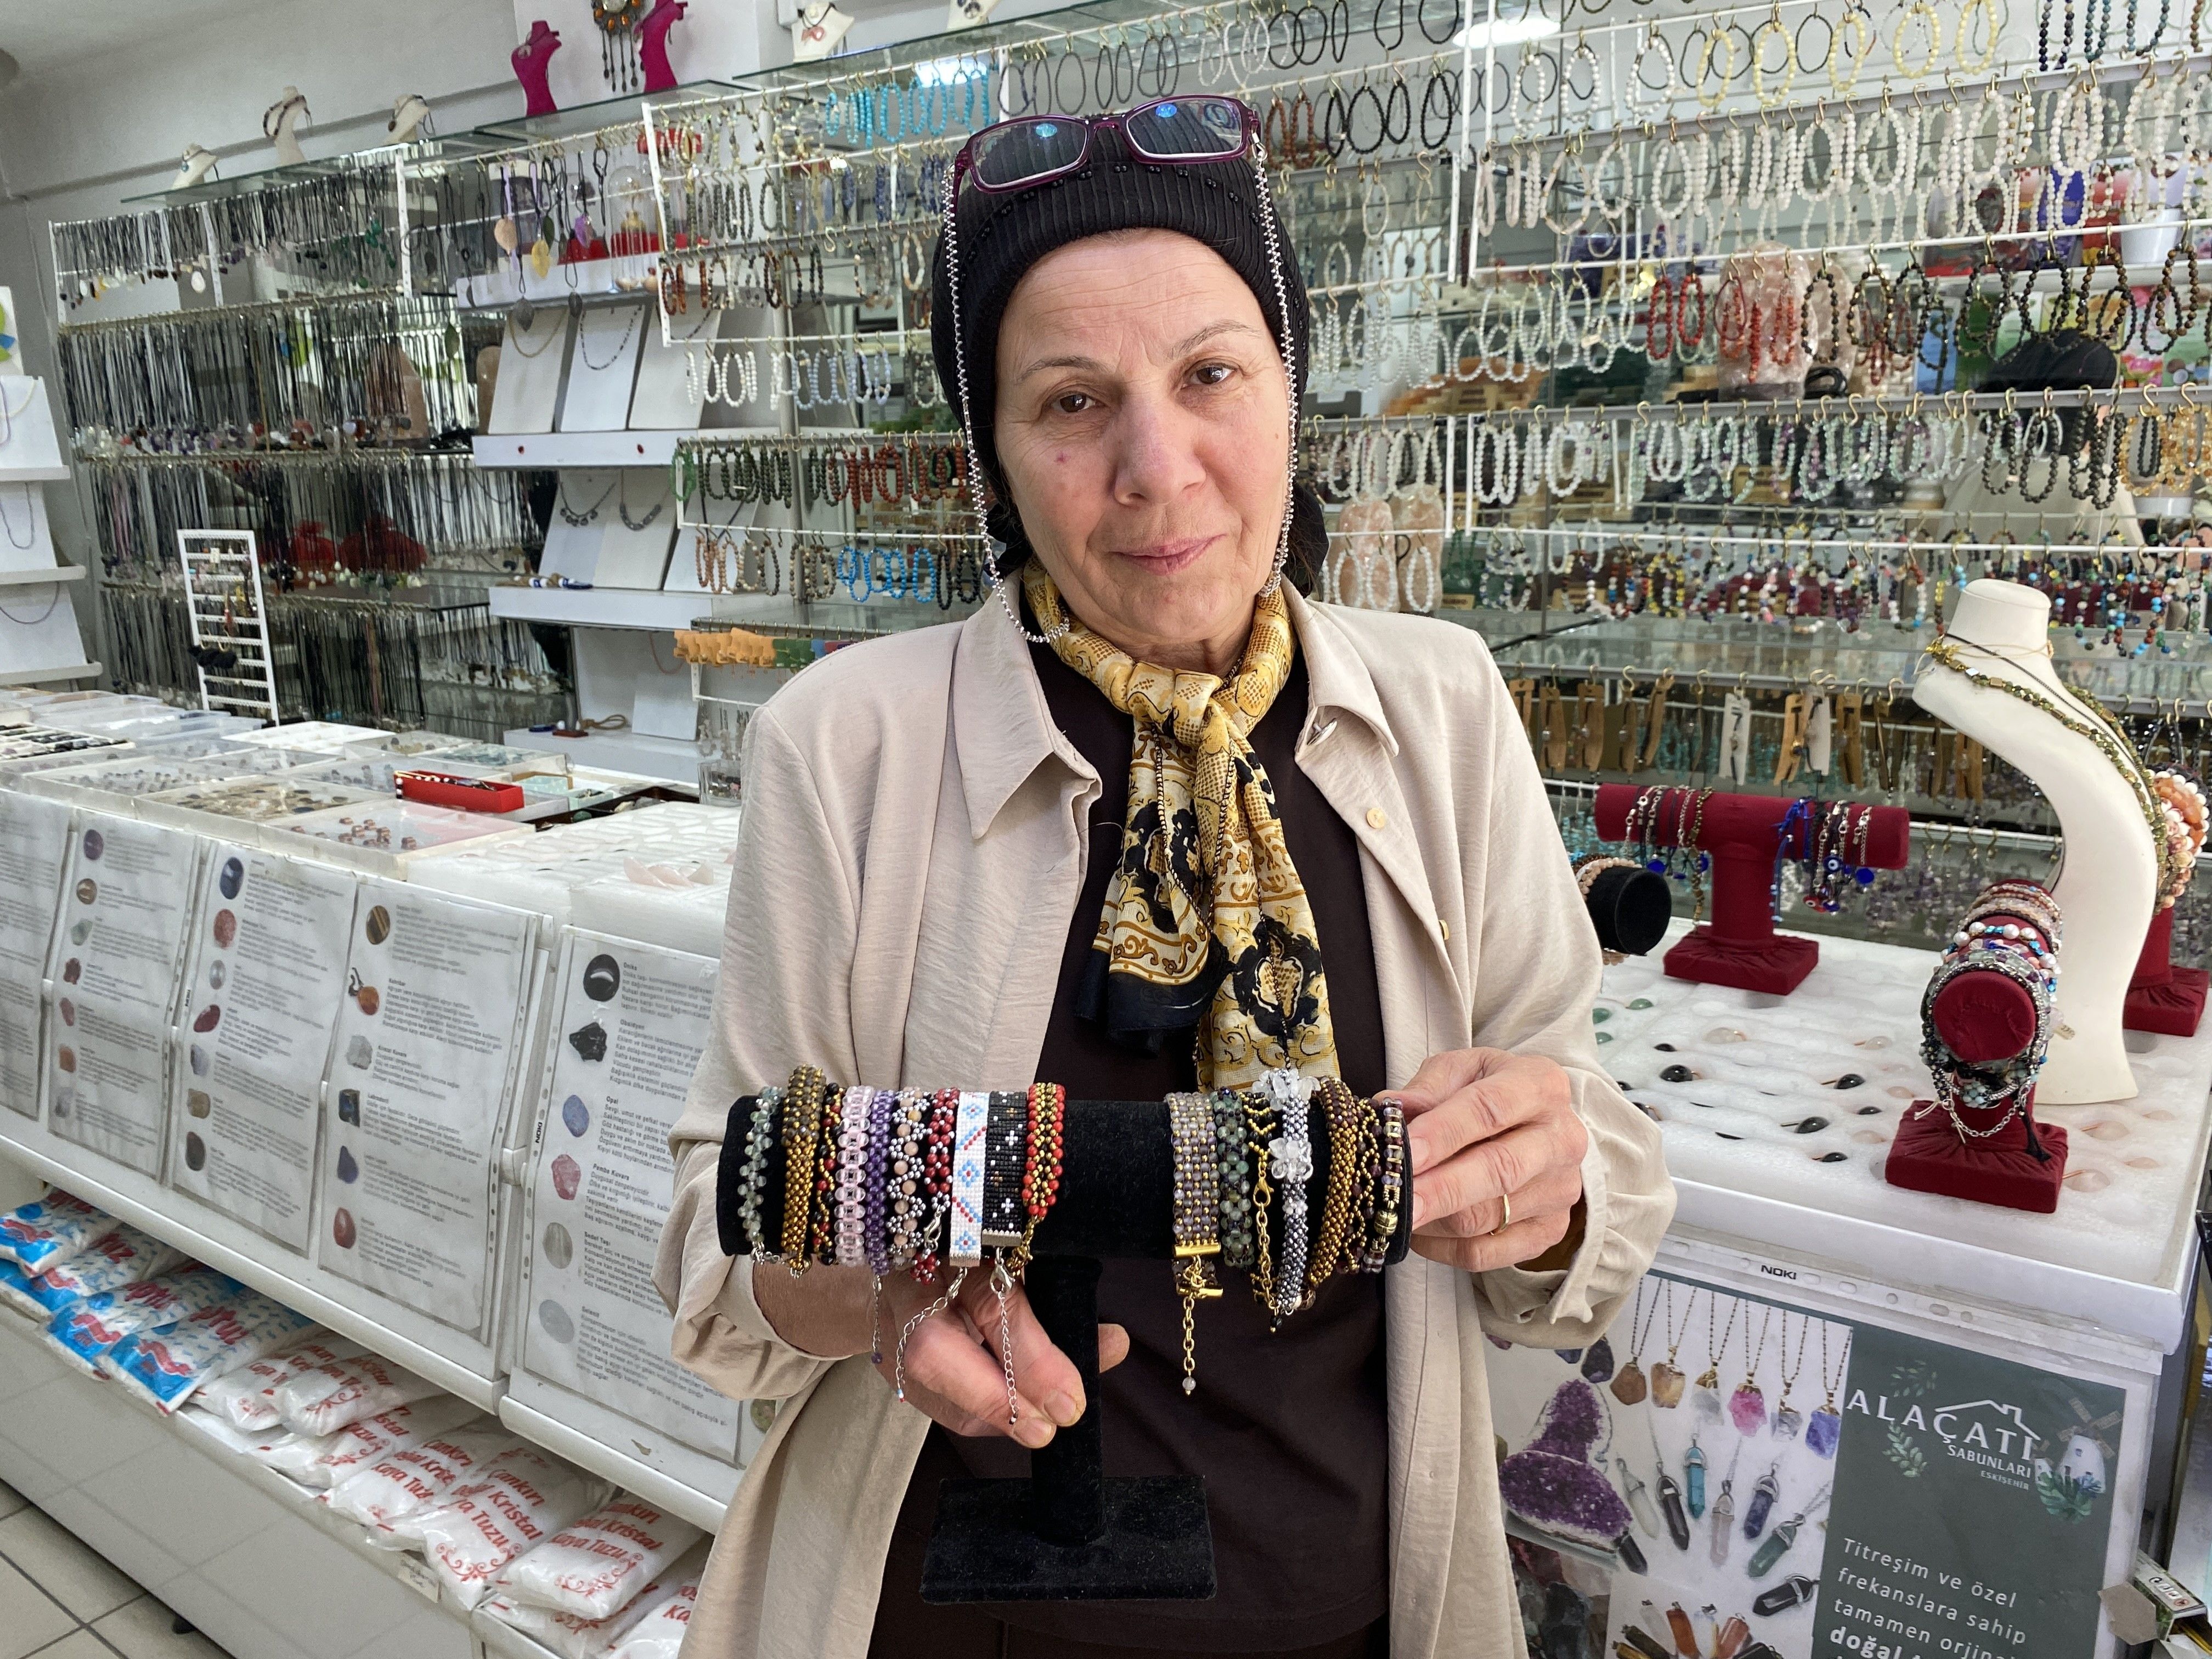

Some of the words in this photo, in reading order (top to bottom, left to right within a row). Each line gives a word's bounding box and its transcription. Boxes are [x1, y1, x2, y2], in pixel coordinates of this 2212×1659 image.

[606, 1096, 619, 1104] Opal
[593, 1164, 610, 1173] Pembe
[611, 1170, 629, 1180] Kuvars
[1760, 1265, 1797, 1280] NOKI
[1846, 1389, 2034, 1460] ALAÇATI
[1947, 1444, 2031, 1478] SABUNLARI
[487, 1469, 545, 1507] Çankırı
[470, 1510, 509, 1549] Tuzu
[488, 1491, 544, 1540] Kristal
[1844, 1538, 1929, 1579] Titreşim
[1939, 1572, 1962, 1589] ve
[1971, 1582, 2017, 1609] özel
[1835, 1599, 1931, 1643] tamamen
[1838, 1567, 1958, 1621] frekanslara
[1966, 1615, 2027, 1645] sahip
[1830, 1626, 1902, 1659] doğal
